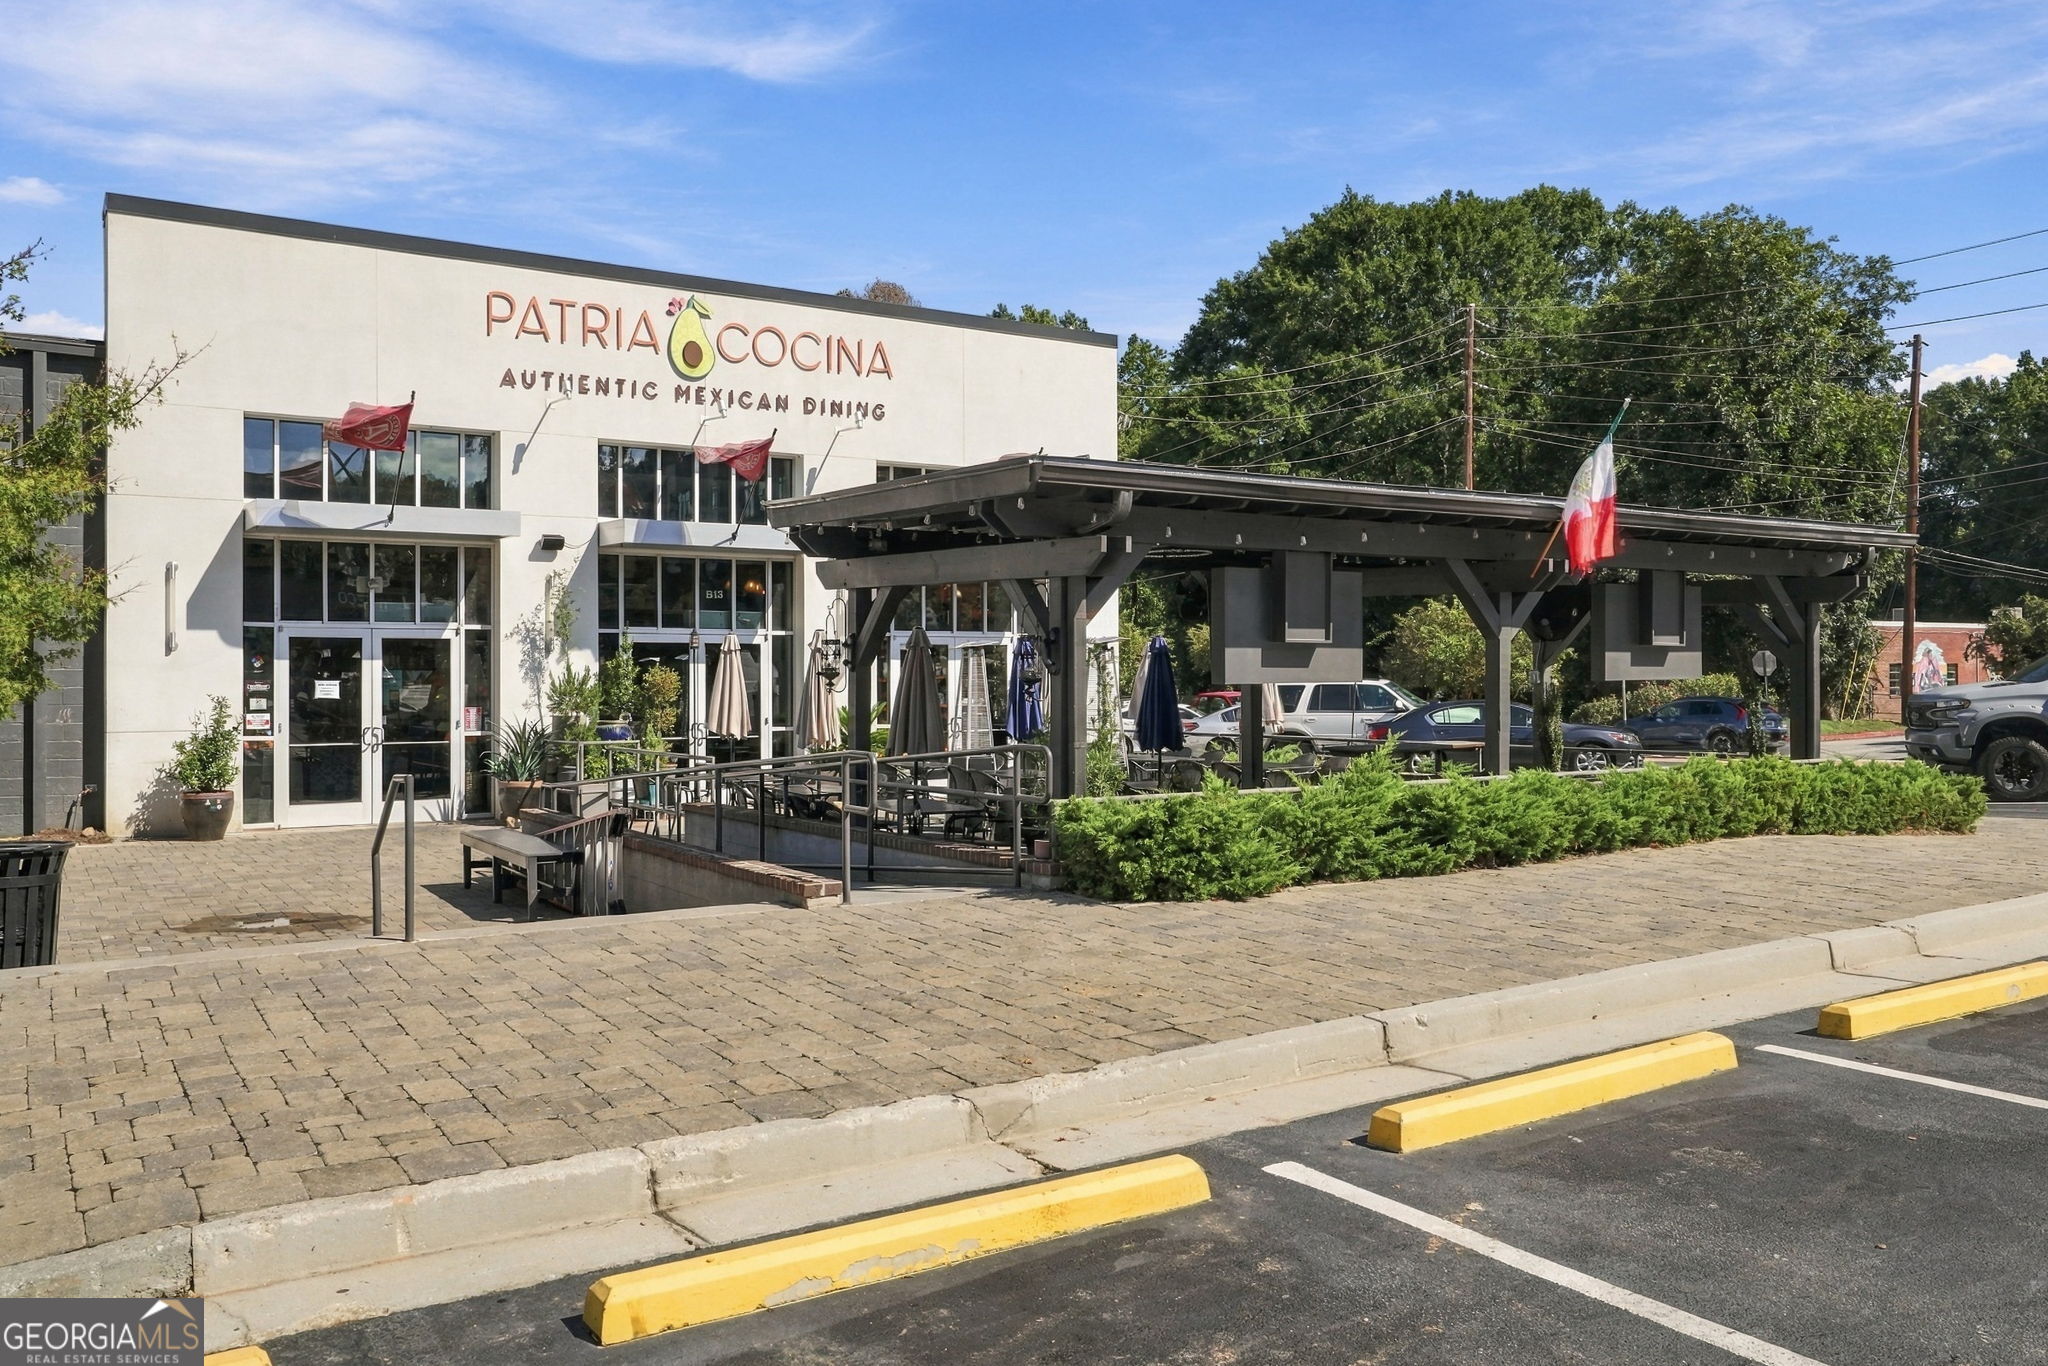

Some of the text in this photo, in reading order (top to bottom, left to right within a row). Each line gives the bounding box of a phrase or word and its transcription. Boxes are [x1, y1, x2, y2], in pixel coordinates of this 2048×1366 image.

[486, 291, 893, 380] PATRIA COCINA
[499, 367, 886, 421] AUTHENTIC MEXICAN DINING
[706, 590, 724, 599] B13
